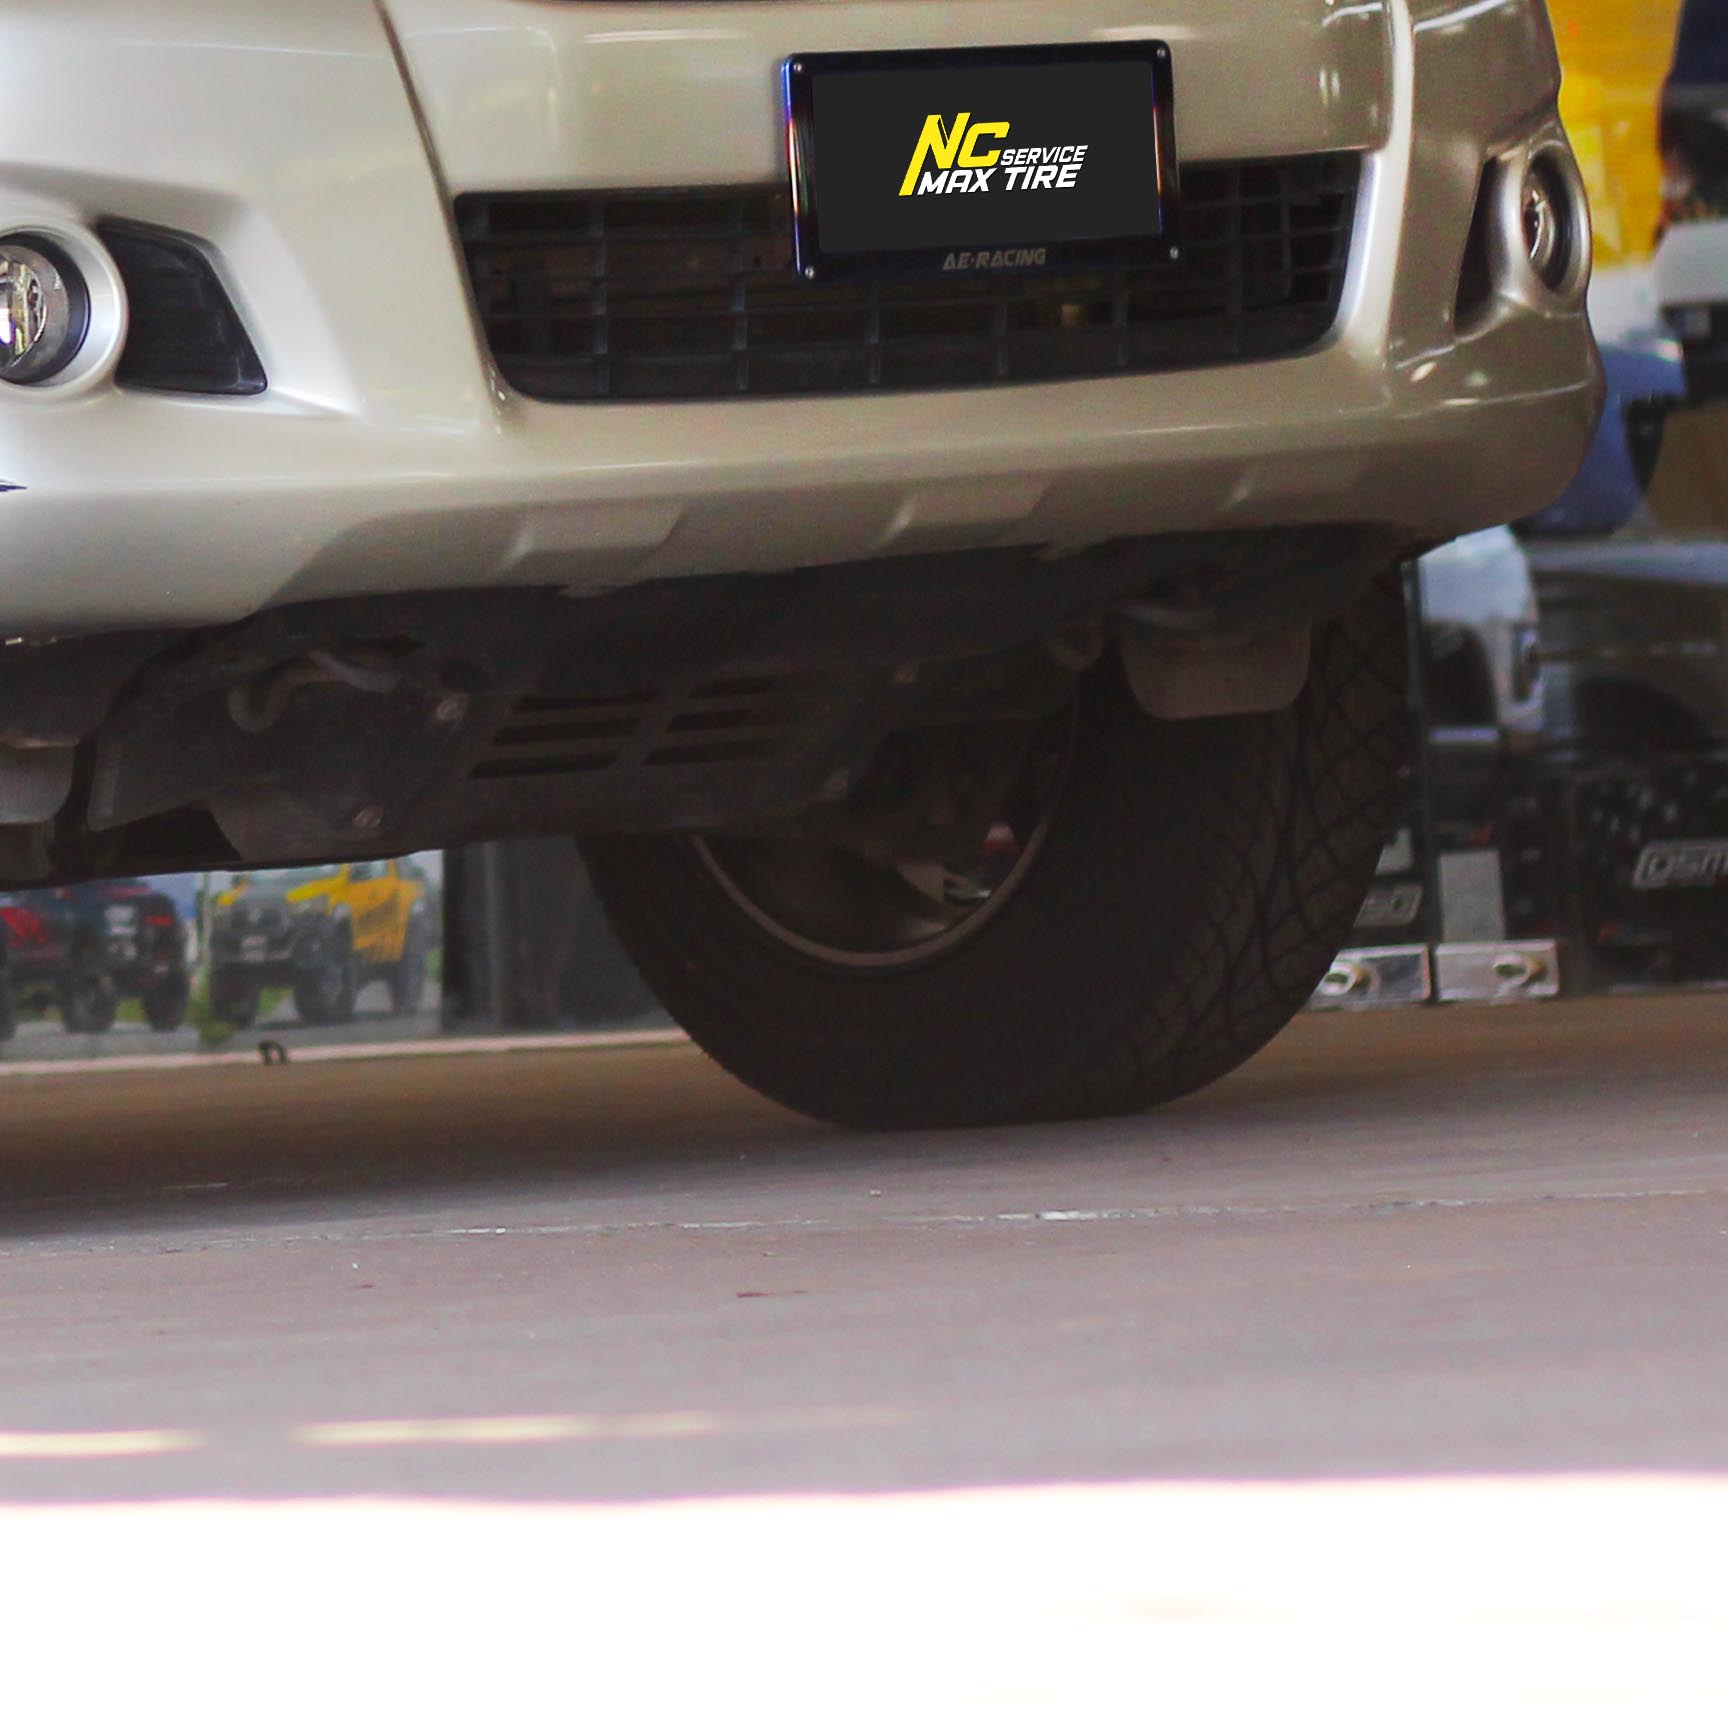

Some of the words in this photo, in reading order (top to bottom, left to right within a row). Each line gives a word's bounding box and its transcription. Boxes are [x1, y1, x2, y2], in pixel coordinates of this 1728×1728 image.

[899, 112, 1010, 196] NC
[1000, 145, 1088, 165] SERVICE
[917, 166, 1001, 196] MAX
[1004, 162, 1082, 191] TIRE
